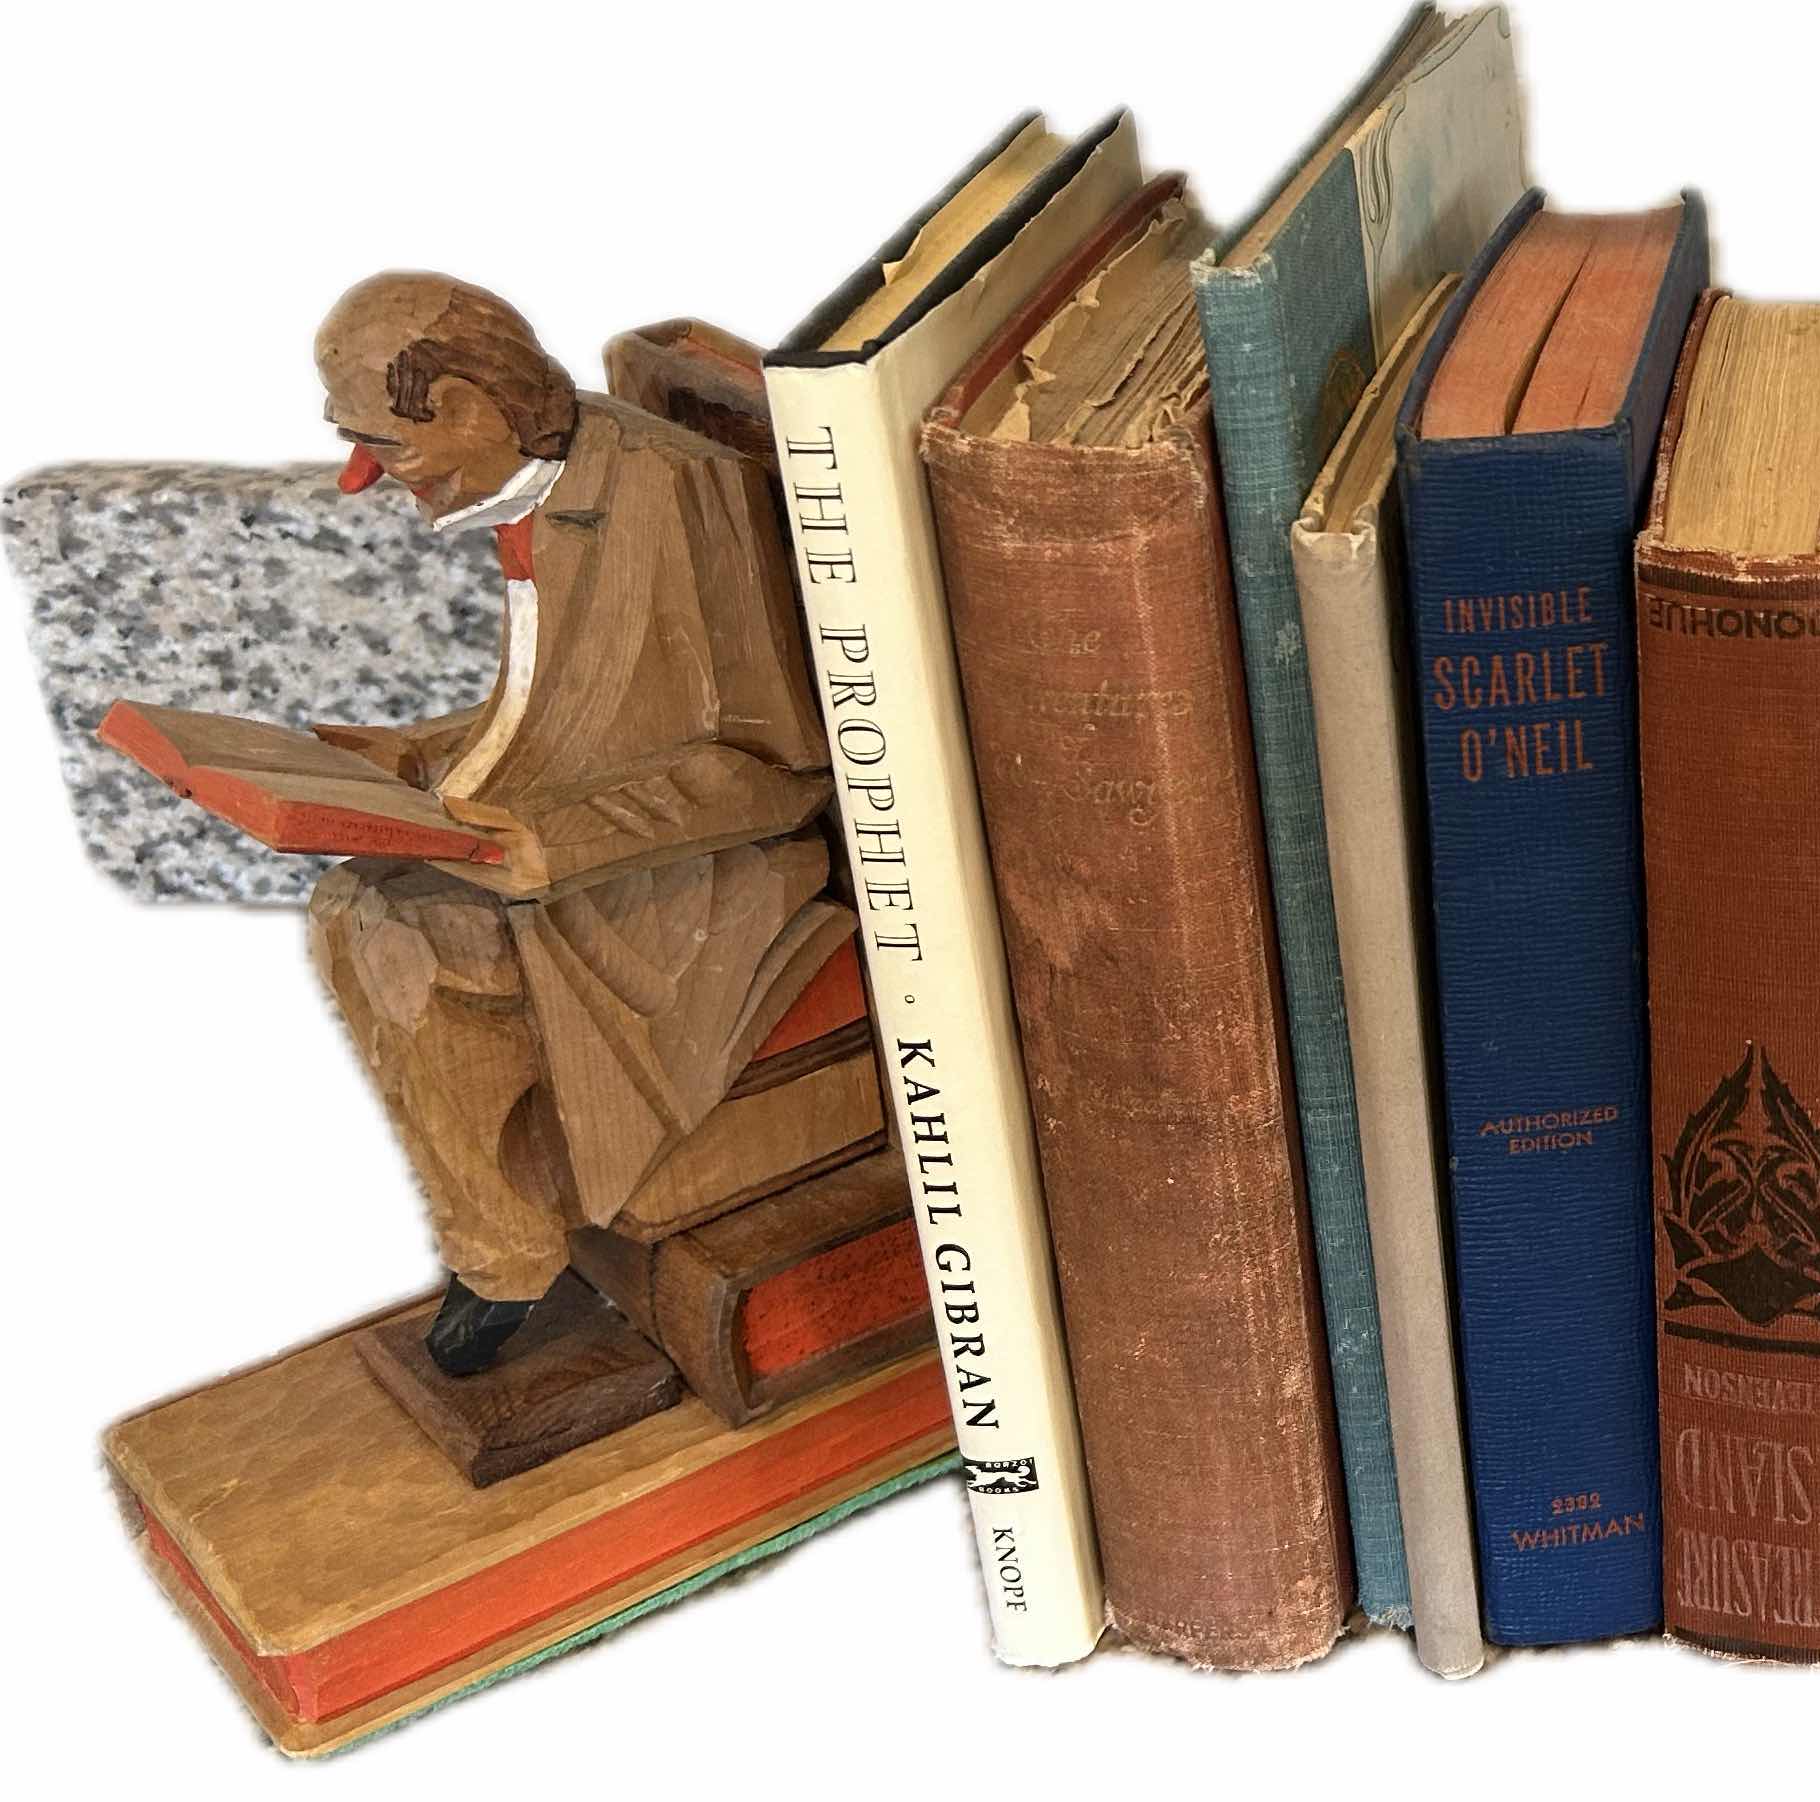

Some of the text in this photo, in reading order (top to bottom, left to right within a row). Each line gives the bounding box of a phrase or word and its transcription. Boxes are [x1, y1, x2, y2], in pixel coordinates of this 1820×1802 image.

[1443, 585, 1592, 634] INVISIBLE
[1433, 642, 1608, 711] SCARLET
[1460, 719, 1594, 783] O'NEIL
[786, 425, 1000, 1430] THE PROPHET KAHLIL GIBRAN
[1478, 1105, 1618, 1136] AUTHORIZED
[1508, 1131, 1593, 1155] EDITION
[1510, 1511, 1646, 1552] WHITMAN
[992, 1527, 1028, 1613] KNOPF
